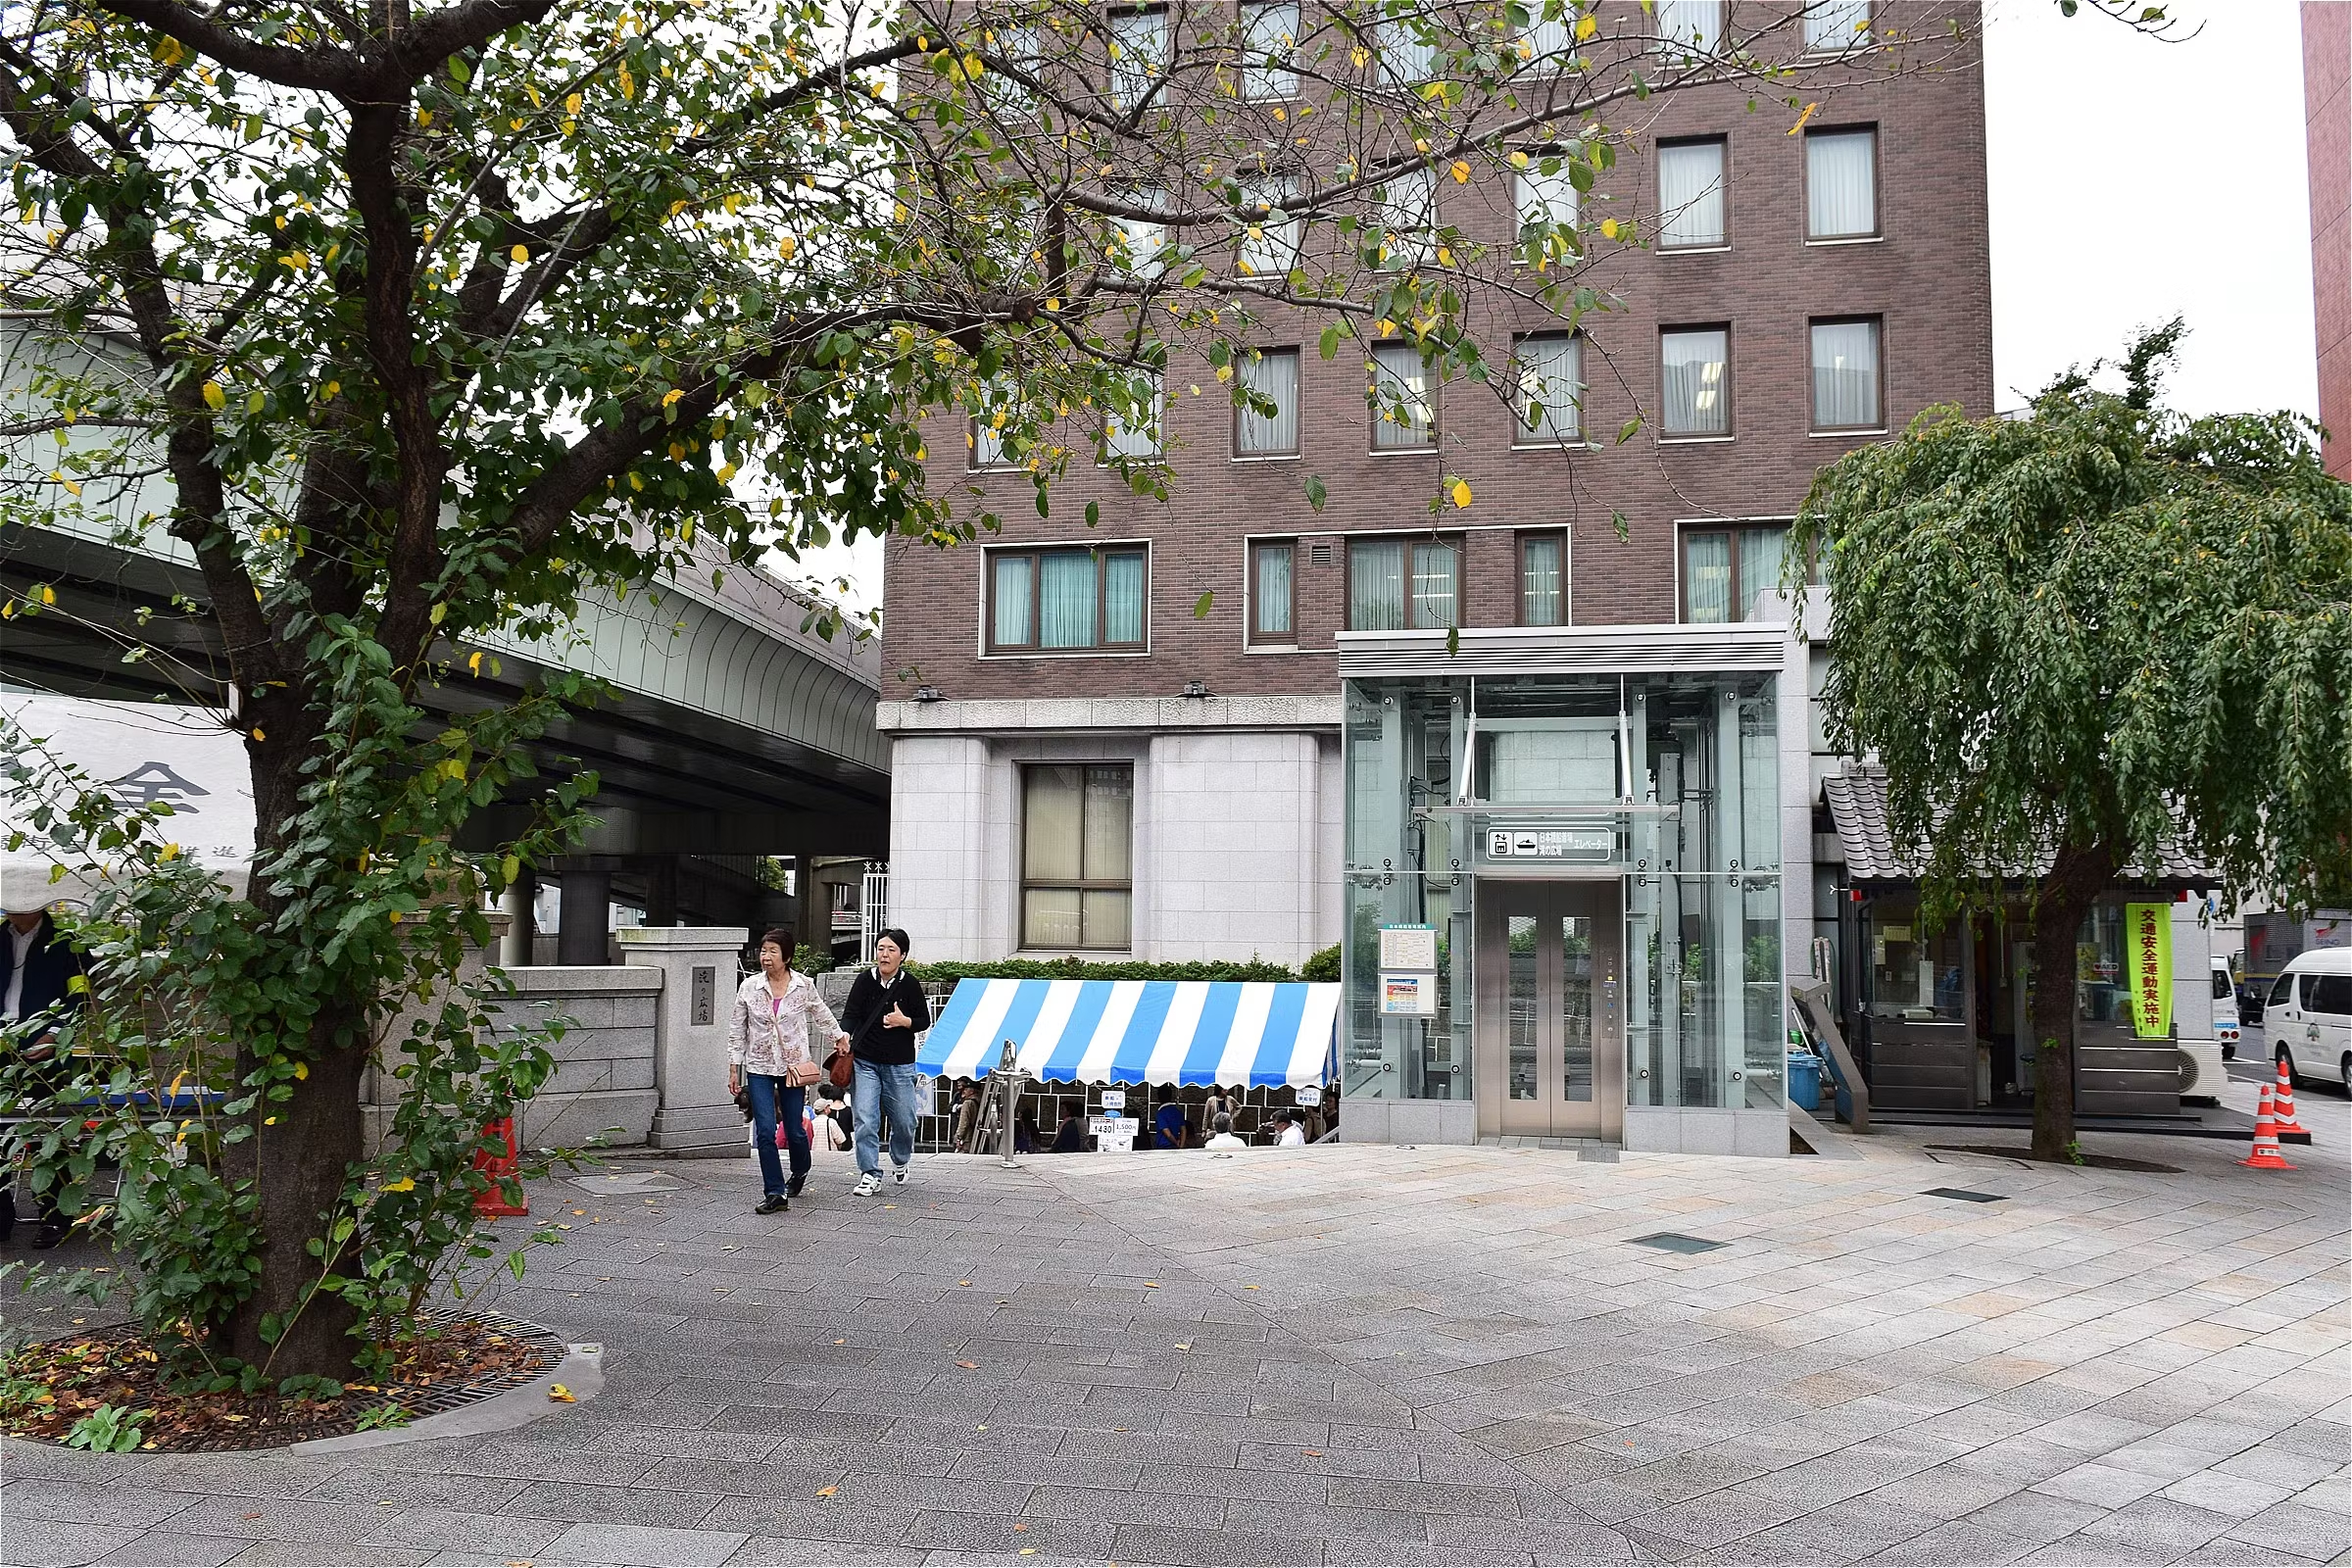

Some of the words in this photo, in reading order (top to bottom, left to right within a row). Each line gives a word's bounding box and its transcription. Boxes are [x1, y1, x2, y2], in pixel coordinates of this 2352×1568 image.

[1573, 839, 1608, 850] エレベーター
[2140, 908, 2160, 1028] 交通安全運動実施中
